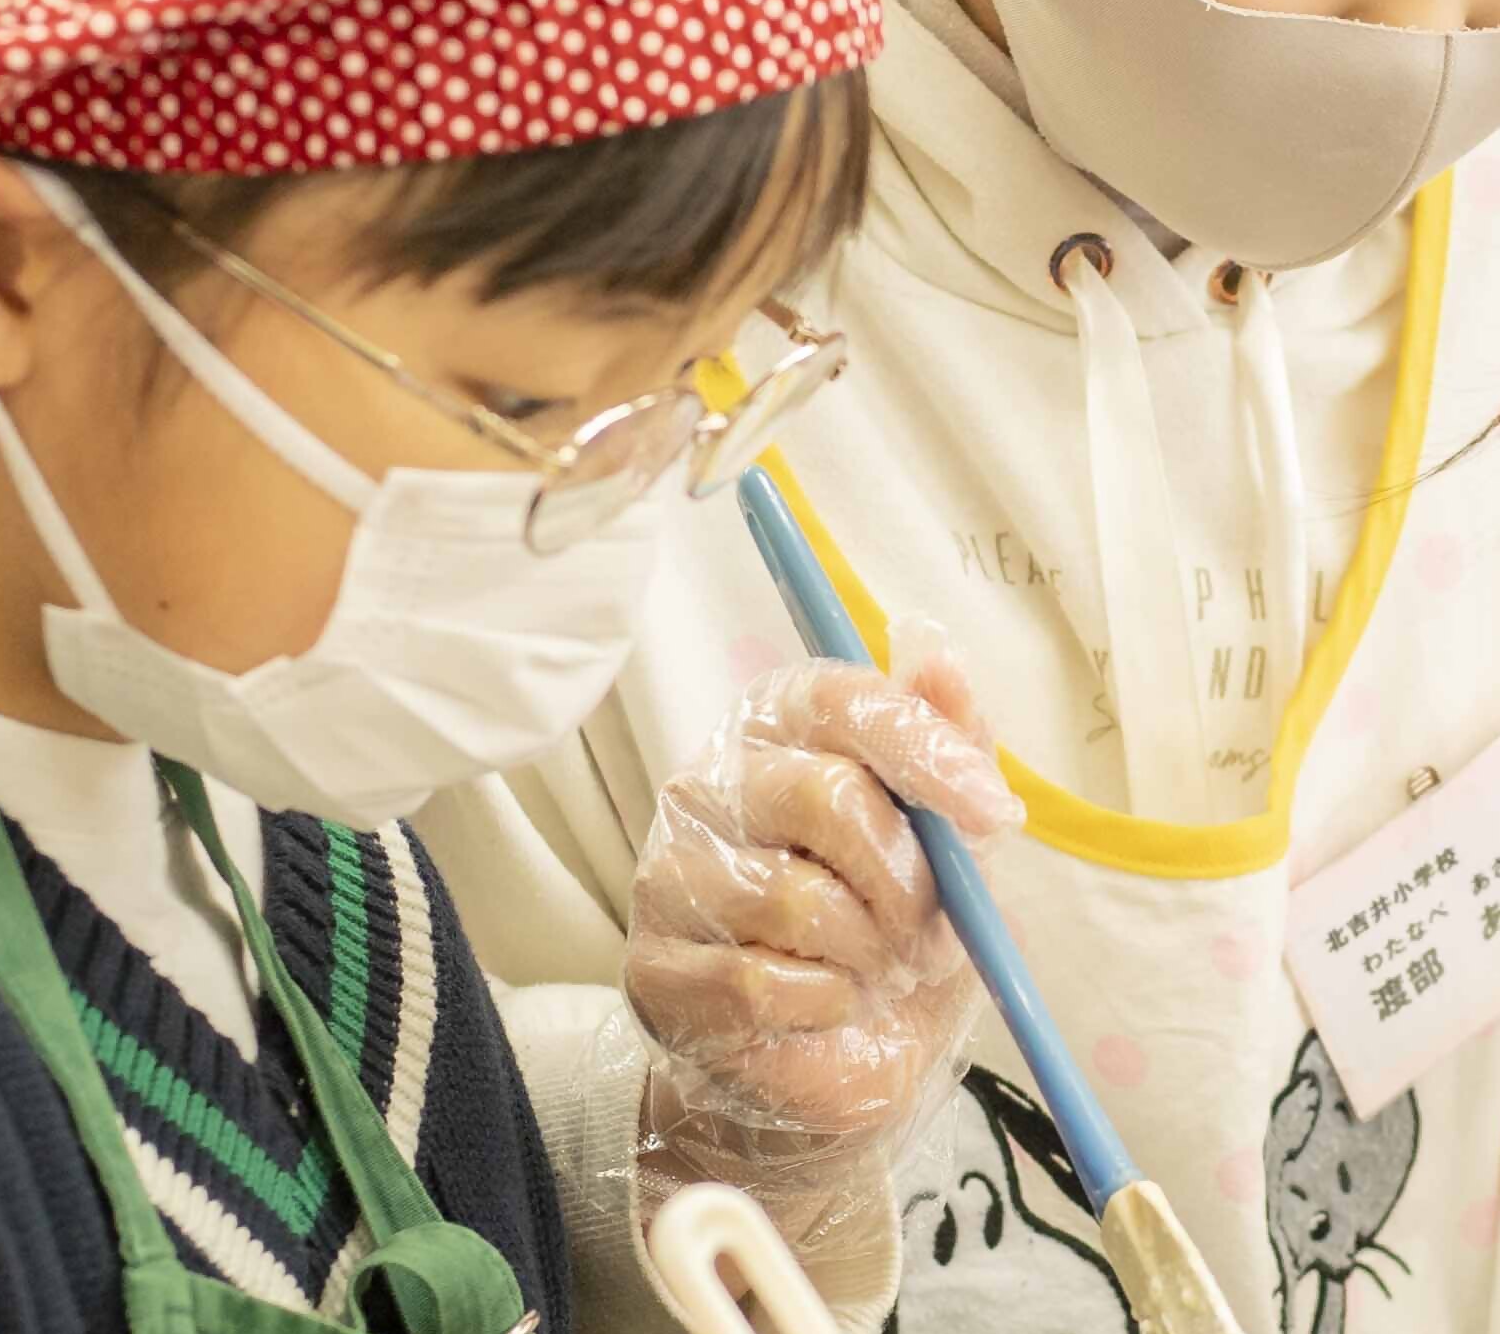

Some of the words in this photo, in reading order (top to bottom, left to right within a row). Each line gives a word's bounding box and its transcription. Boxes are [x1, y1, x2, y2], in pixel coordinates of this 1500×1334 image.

[1325, 847, 1459, 953] 北吉井小学校
[1369, 947, 1445, 1022] 渡部
